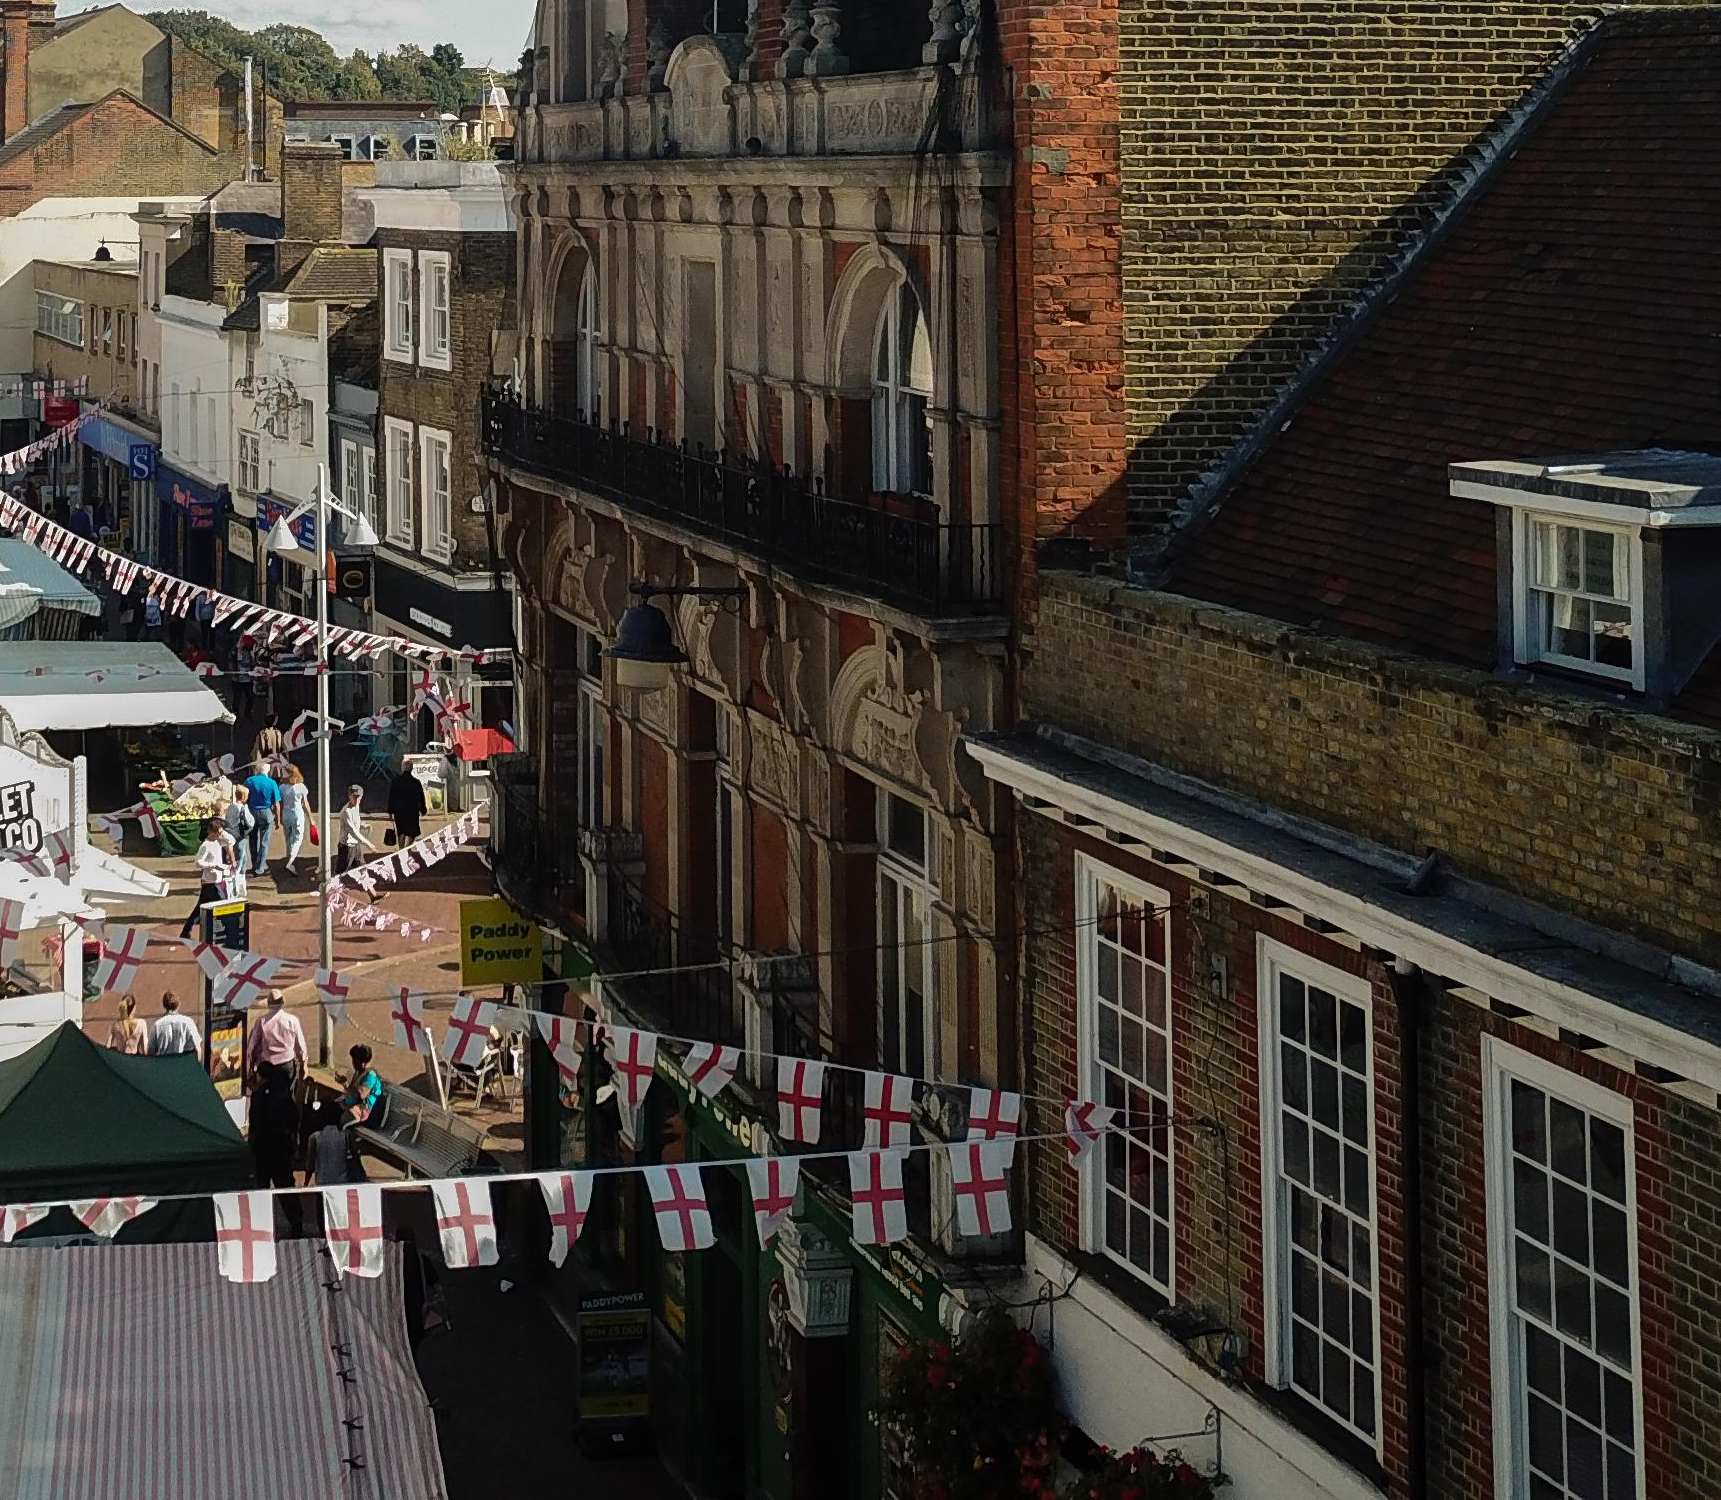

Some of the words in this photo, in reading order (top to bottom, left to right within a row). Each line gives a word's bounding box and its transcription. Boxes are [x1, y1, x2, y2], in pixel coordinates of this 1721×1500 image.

[5, 817, 40, 852] CO
[470, 921, 530, 940] Paddy
[471, 946, 532, 962] Power
[582, 1292, 645, 1309] PADDYPOWER
